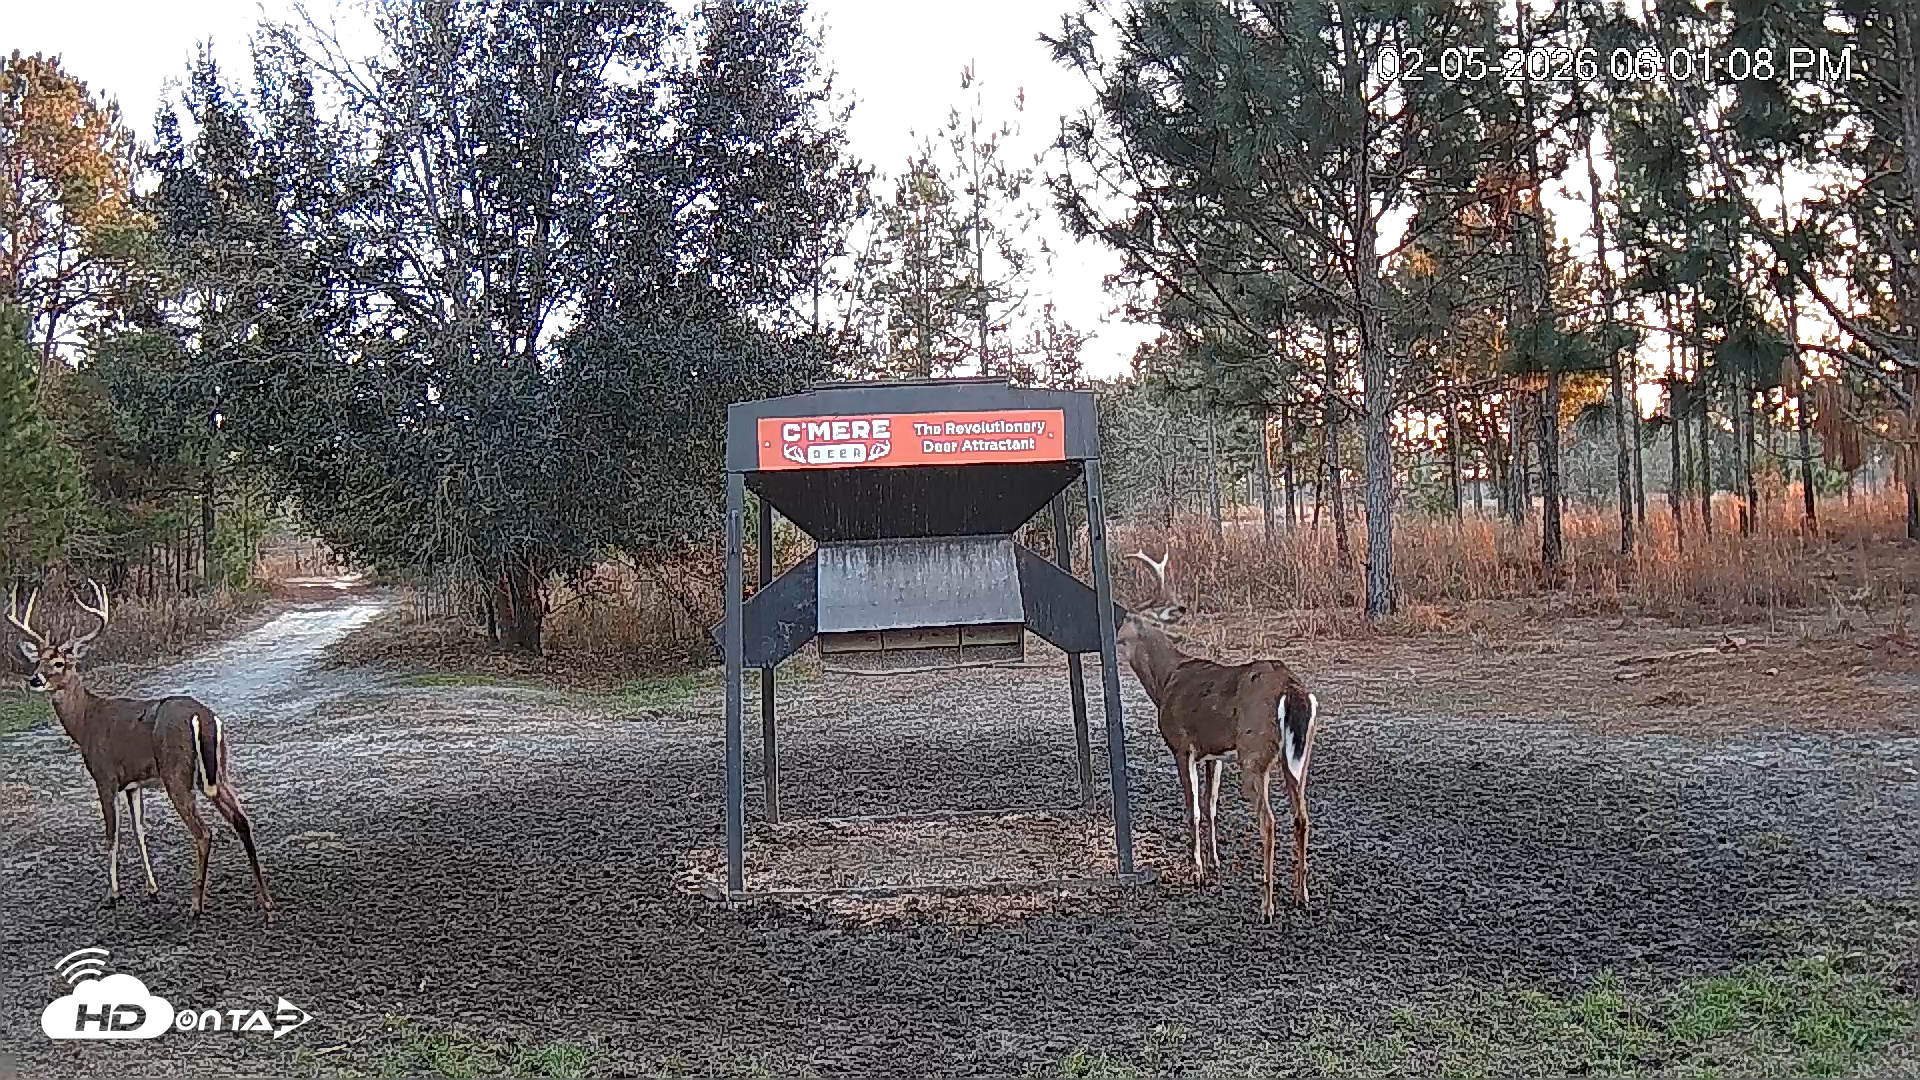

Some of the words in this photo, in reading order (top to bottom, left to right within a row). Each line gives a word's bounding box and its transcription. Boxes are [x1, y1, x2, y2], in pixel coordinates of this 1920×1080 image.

[782, 419, 891, 442] C'MERE
[914, 422, 941, 435] The
[945, 420, 1045, 435] Revolutionary
[923, 440, 958, 453] Deer
[961, 437, 1035, 452] Attractant
[812, 447, 862, 459] DEER
